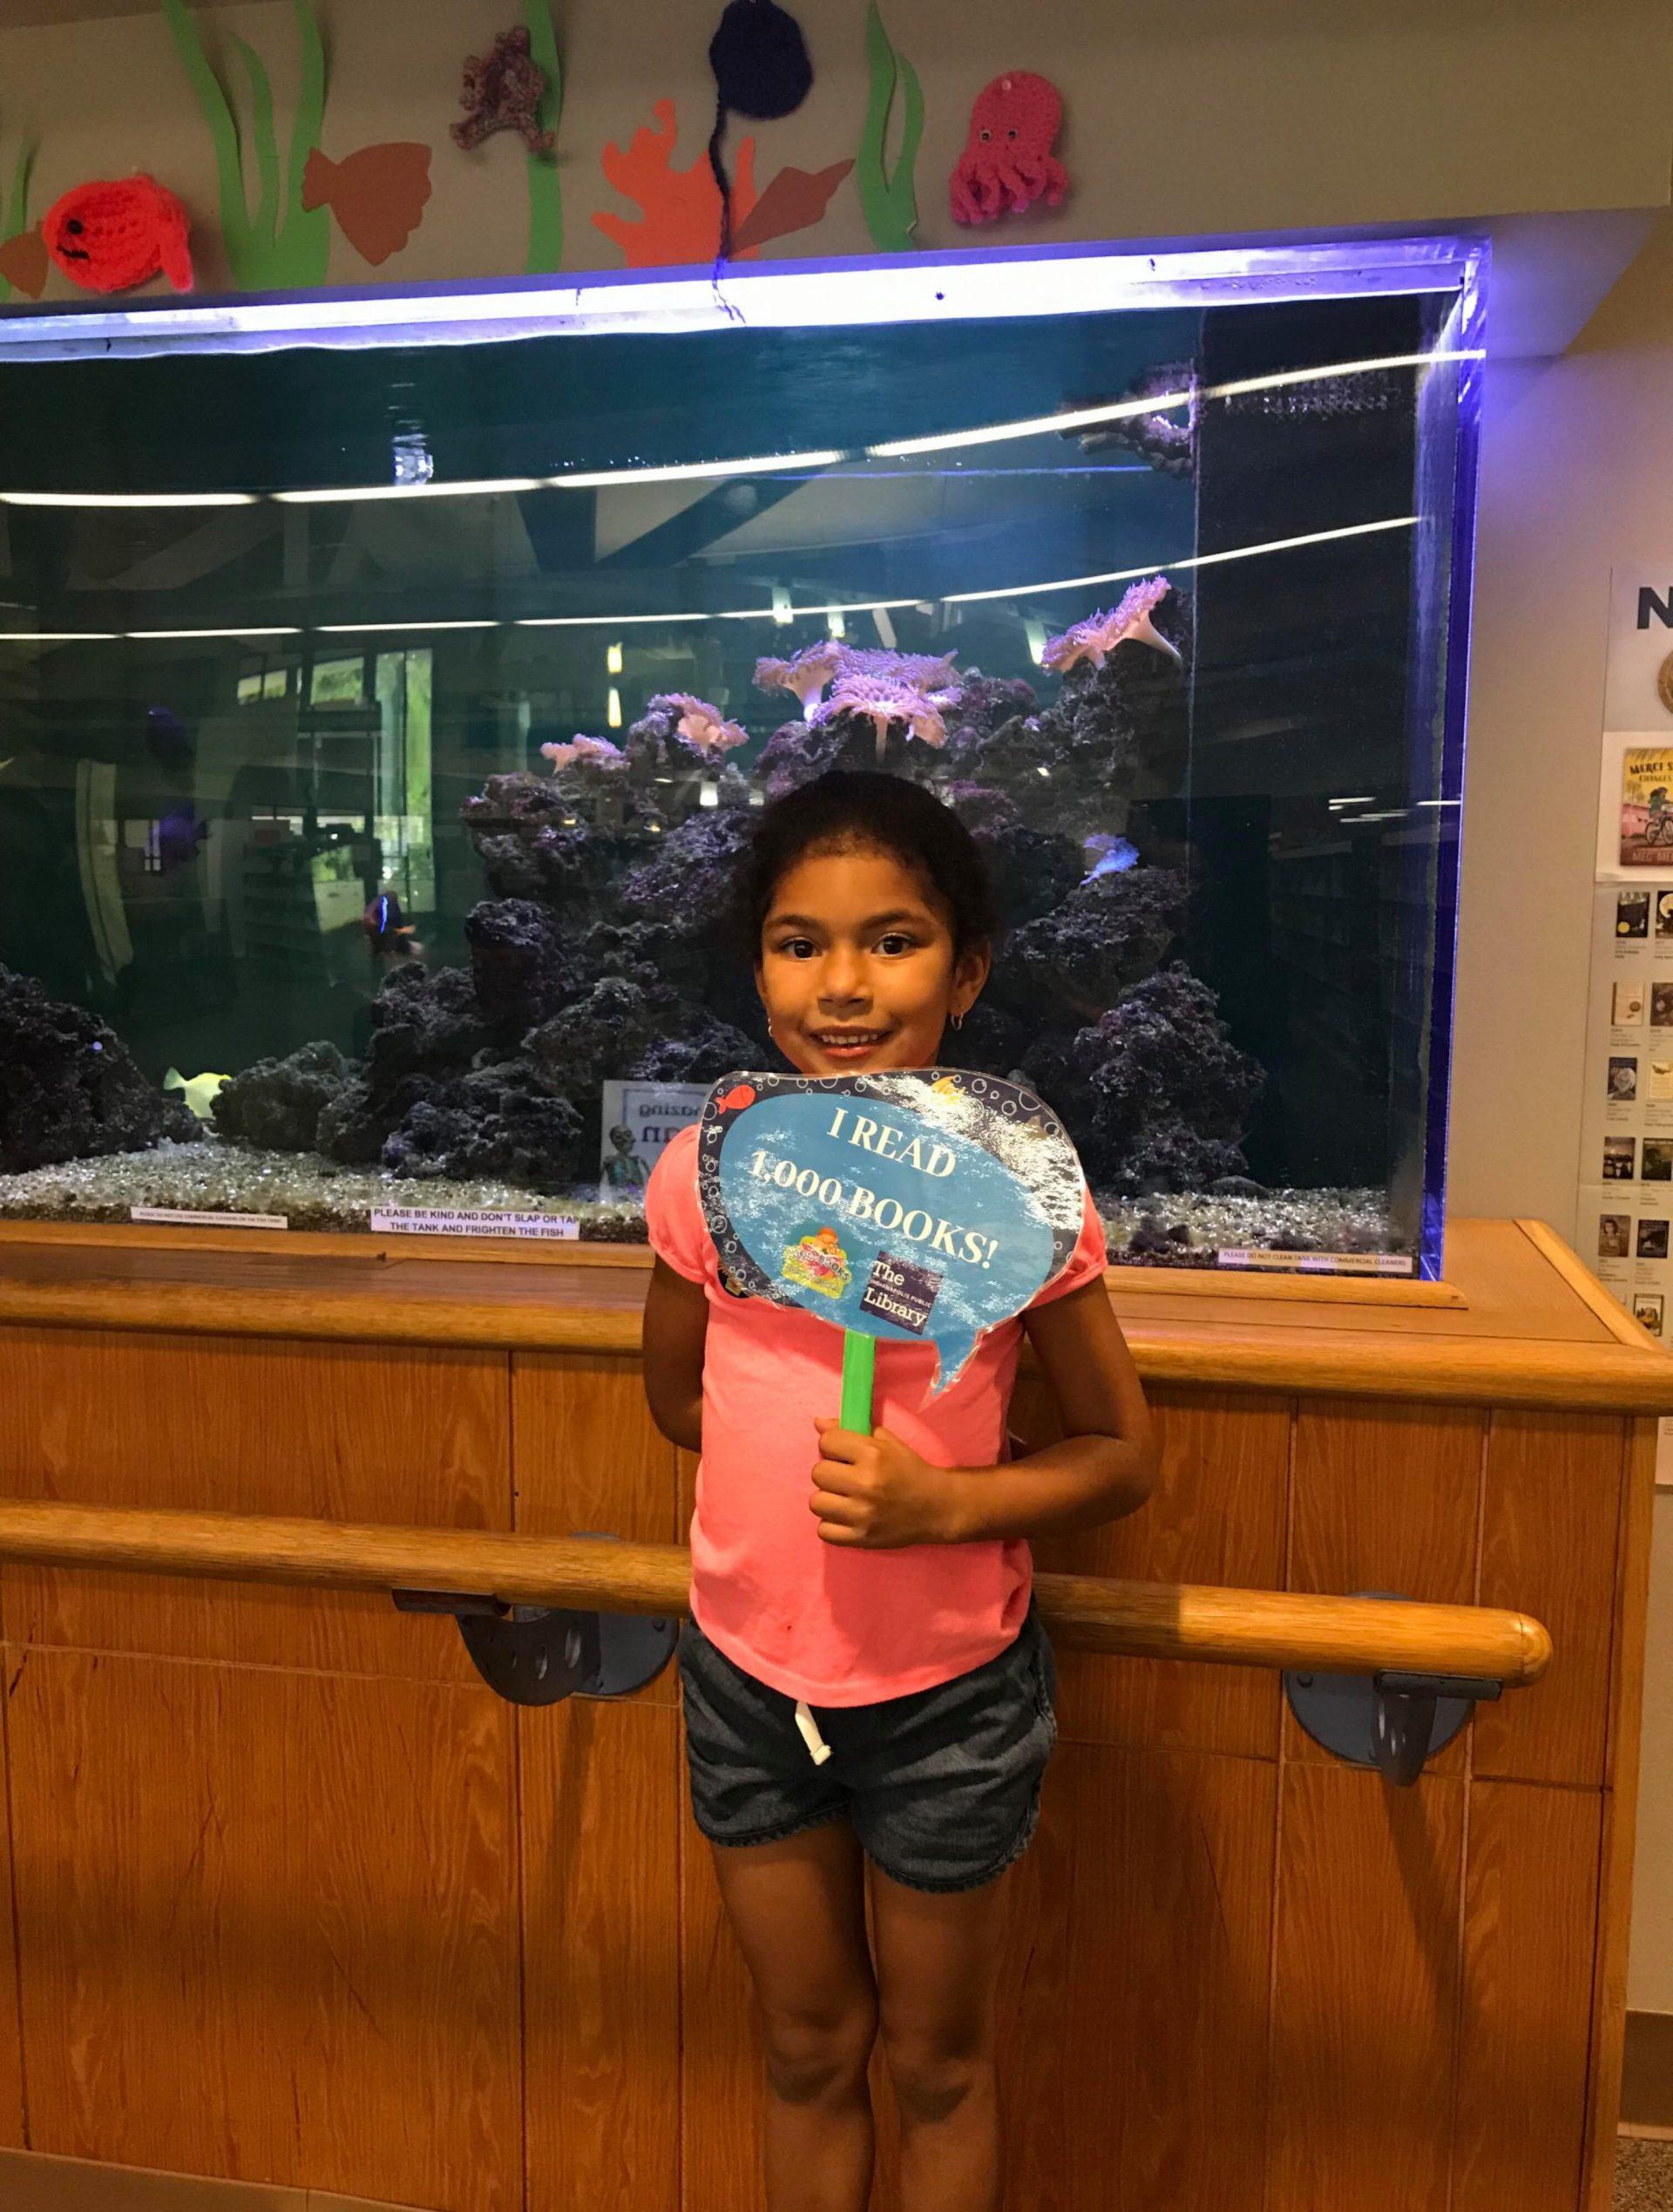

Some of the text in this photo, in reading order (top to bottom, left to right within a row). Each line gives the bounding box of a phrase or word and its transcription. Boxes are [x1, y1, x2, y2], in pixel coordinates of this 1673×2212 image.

[1629, 762, 1663, 775] MERCI
[826, 1107, 956, 1177] I READ
[374, 1208, 412, 1218] PLEASE
[415, 1210, 427, 1218] BE
[430, 1211, 454, 1219] KIND
[457, 1211, 478, 1220] AND
[481, 1212, 511, 1221] DON'T
[515, 1213, 540, 1223] SLAP
[559, 1215, 579, 1224] TAP
[747, 1150, 999, 1269] 1,000 BOOKS!
[390, 1222, 564, 1237] THE TANK AND FRIGHTEN THE FISH
[872, 1260, 904, 1286] The
[864, 1286, 927, 1327] Library
[911, 1295, 931, 1308] PUBLIC
